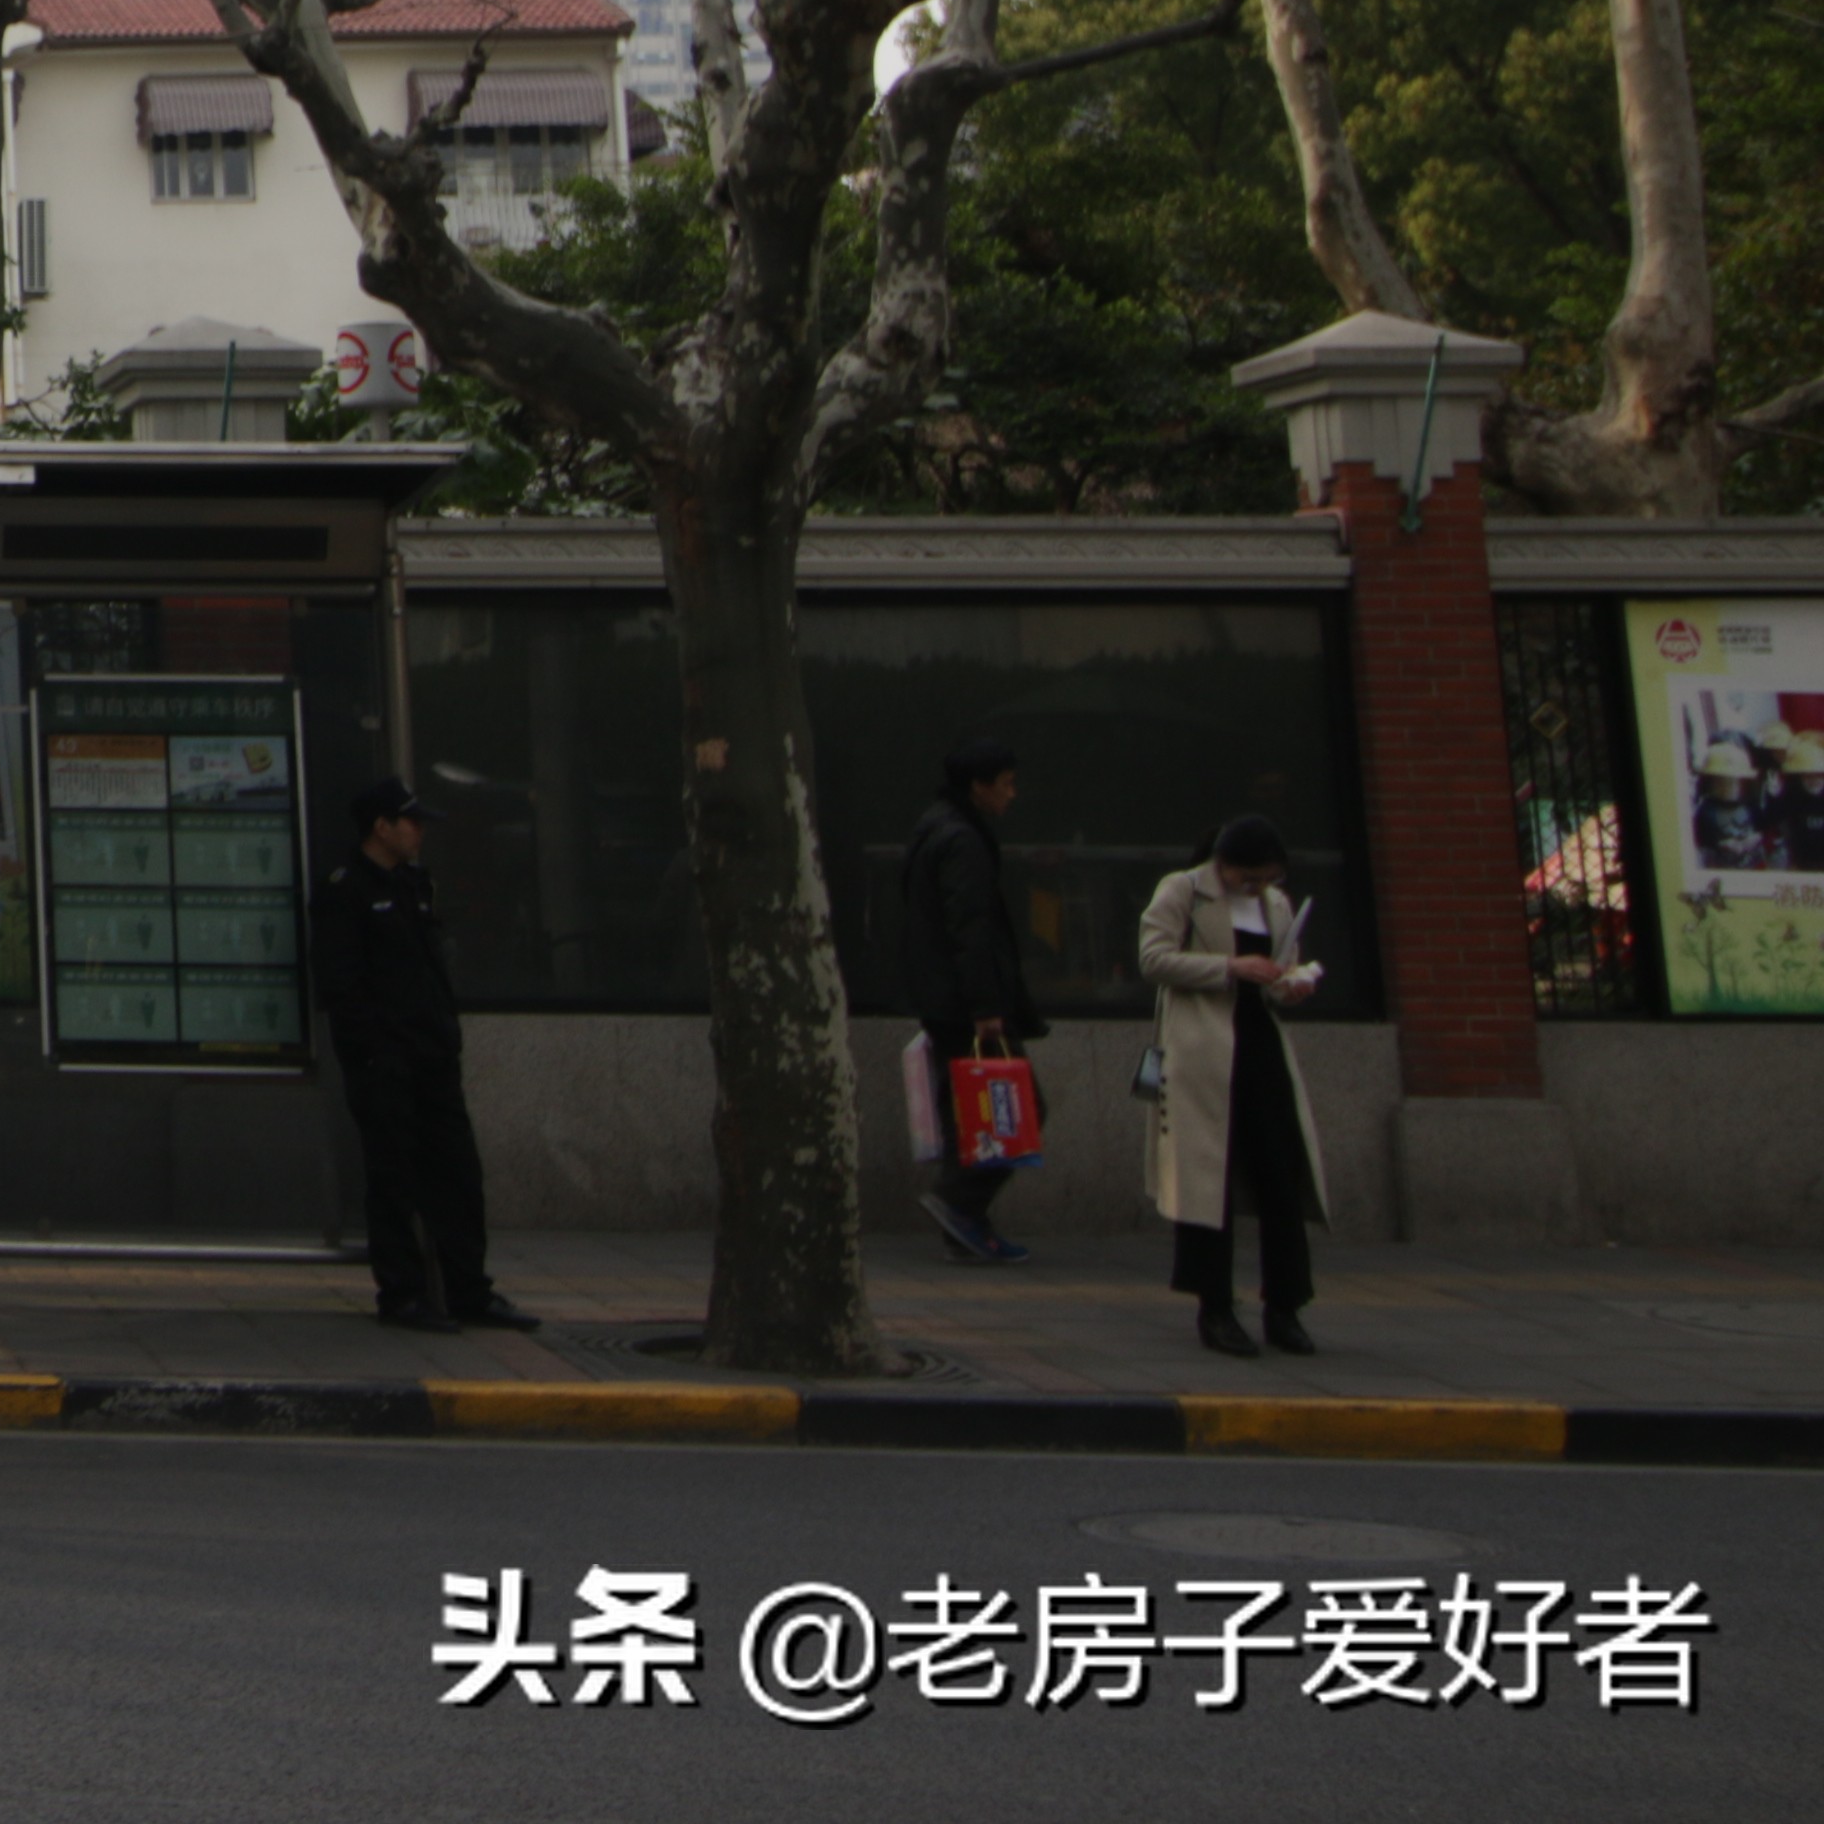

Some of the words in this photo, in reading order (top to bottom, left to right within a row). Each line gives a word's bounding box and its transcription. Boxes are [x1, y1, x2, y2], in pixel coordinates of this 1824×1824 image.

[83, 695, 276, 719] 请自觉遵守乘车秩序
